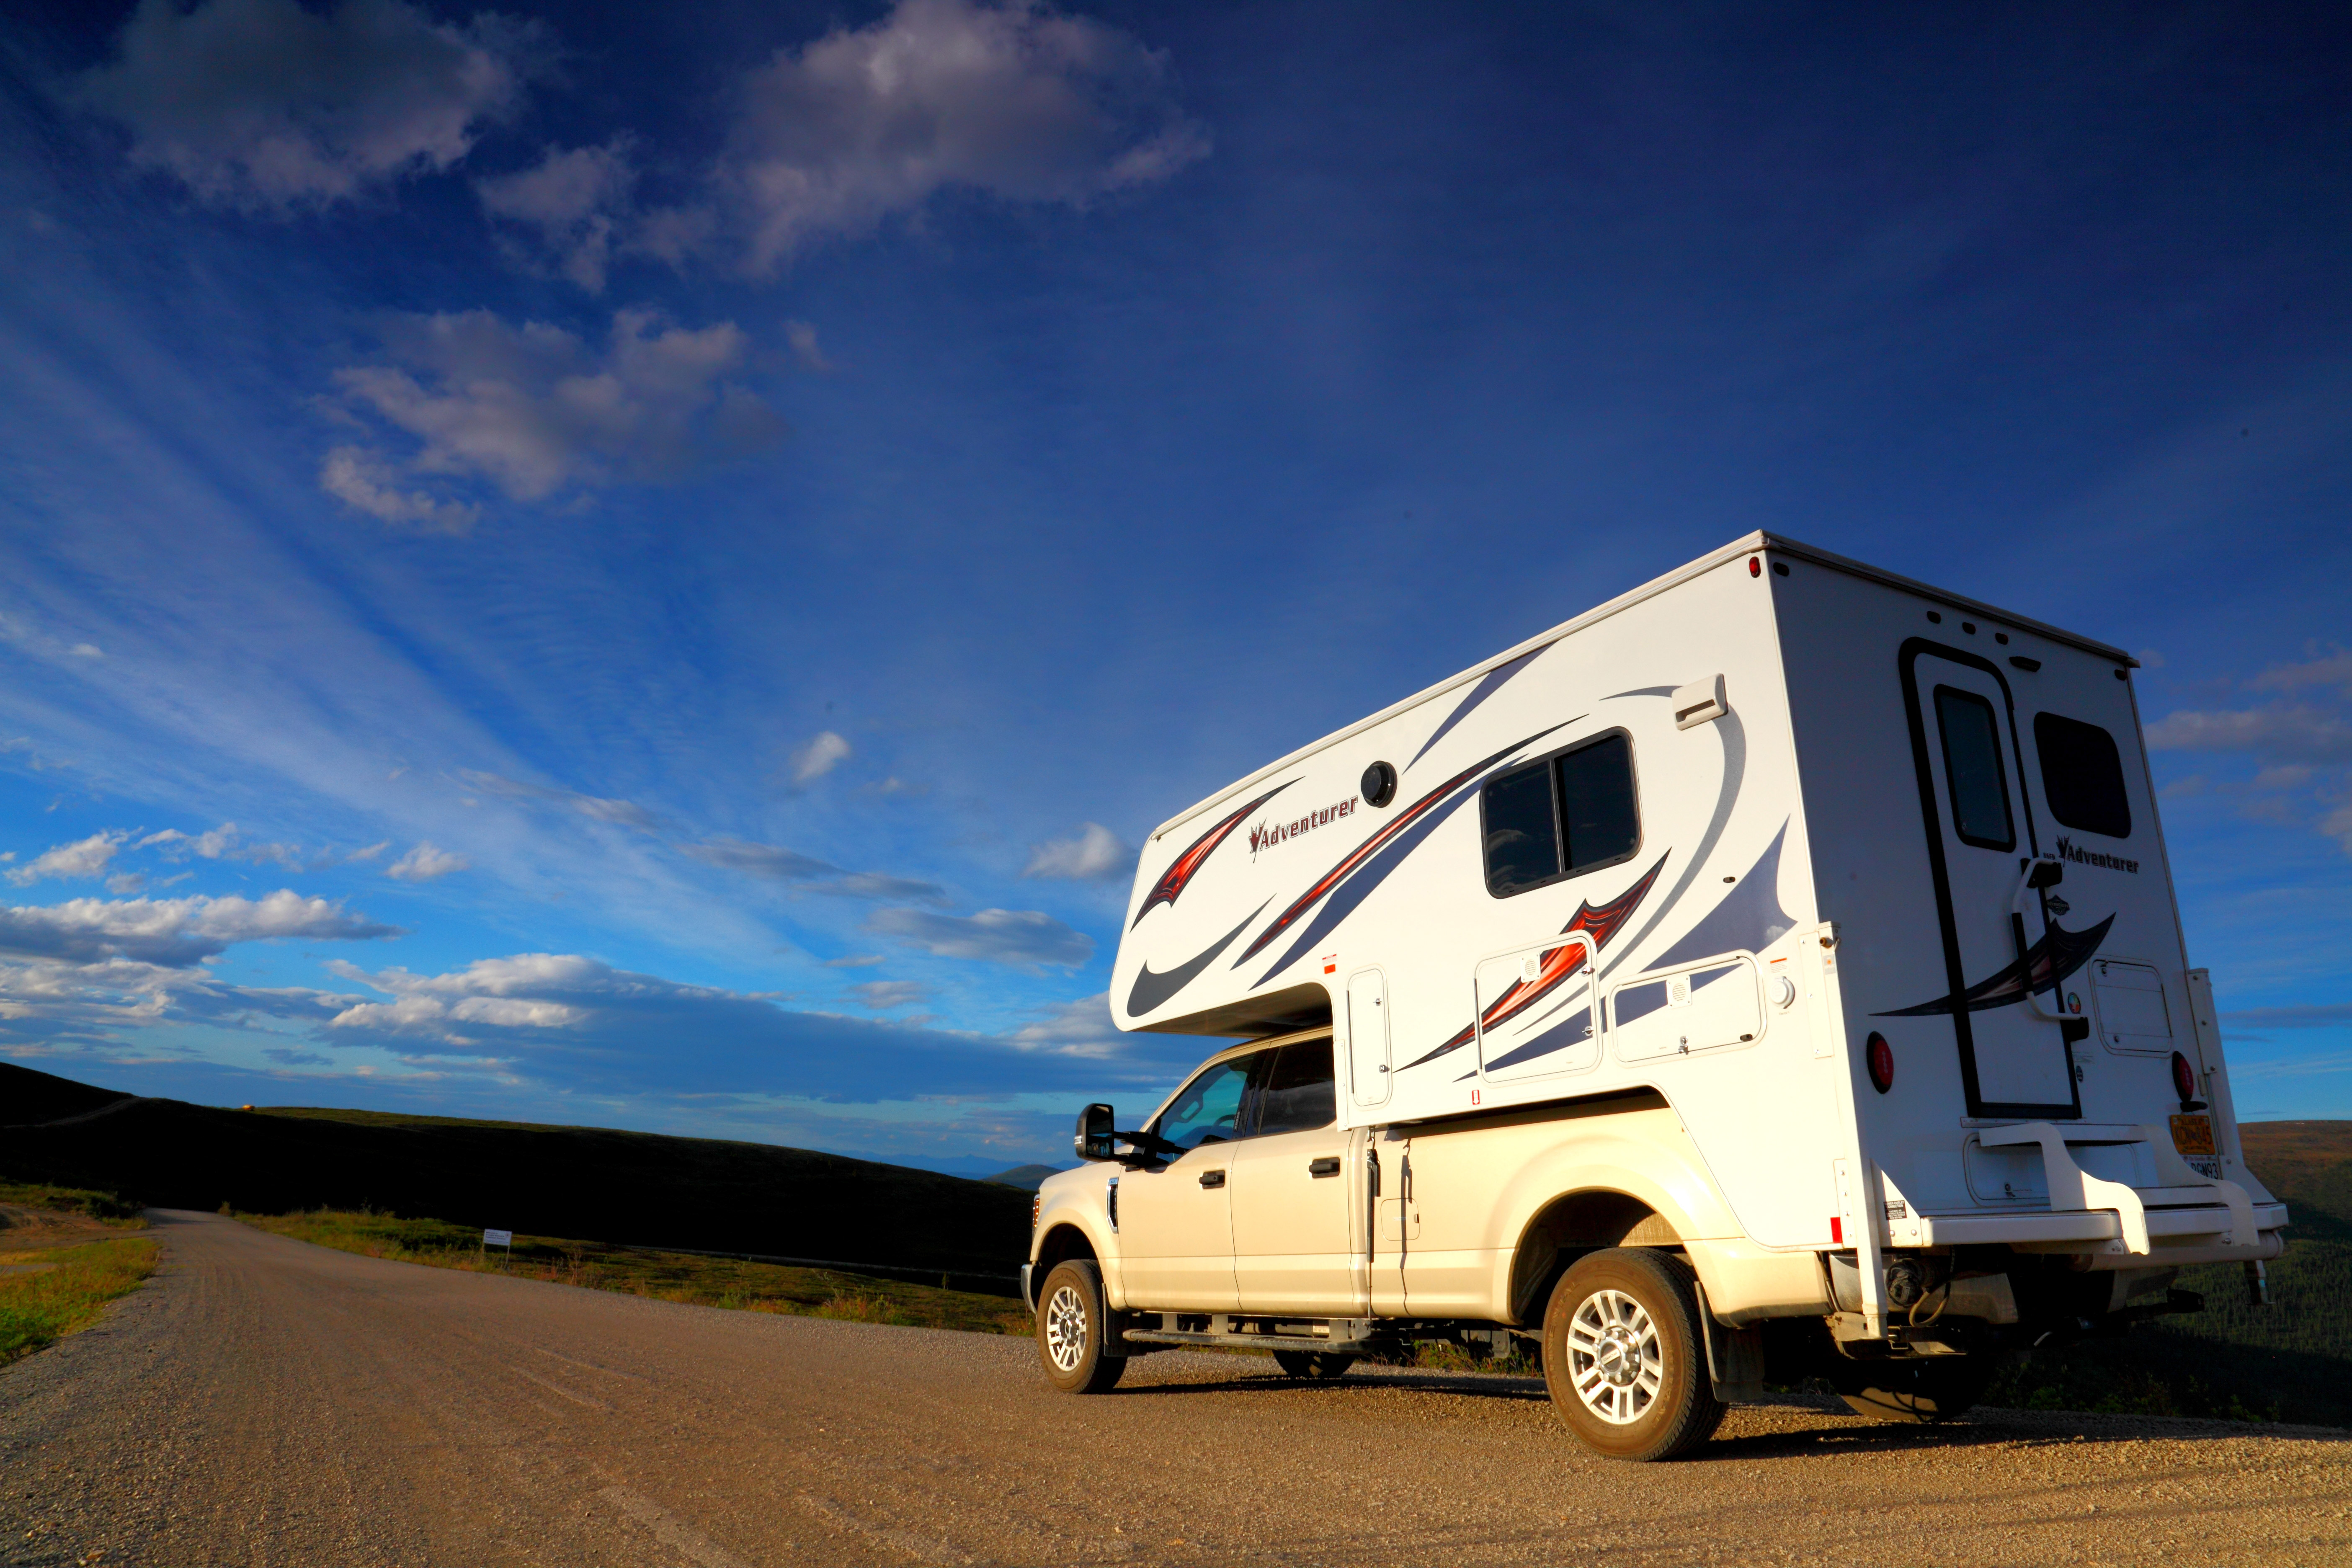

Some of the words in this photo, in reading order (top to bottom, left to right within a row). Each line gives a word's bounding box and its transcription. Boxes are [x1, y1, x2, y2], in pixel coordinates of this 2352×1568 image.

[1259, 795, 1358, 851] Adventurer
[2067, 844, 2139, 874] Adventurer
[1603, 1352, 1617, 1362] FORD
